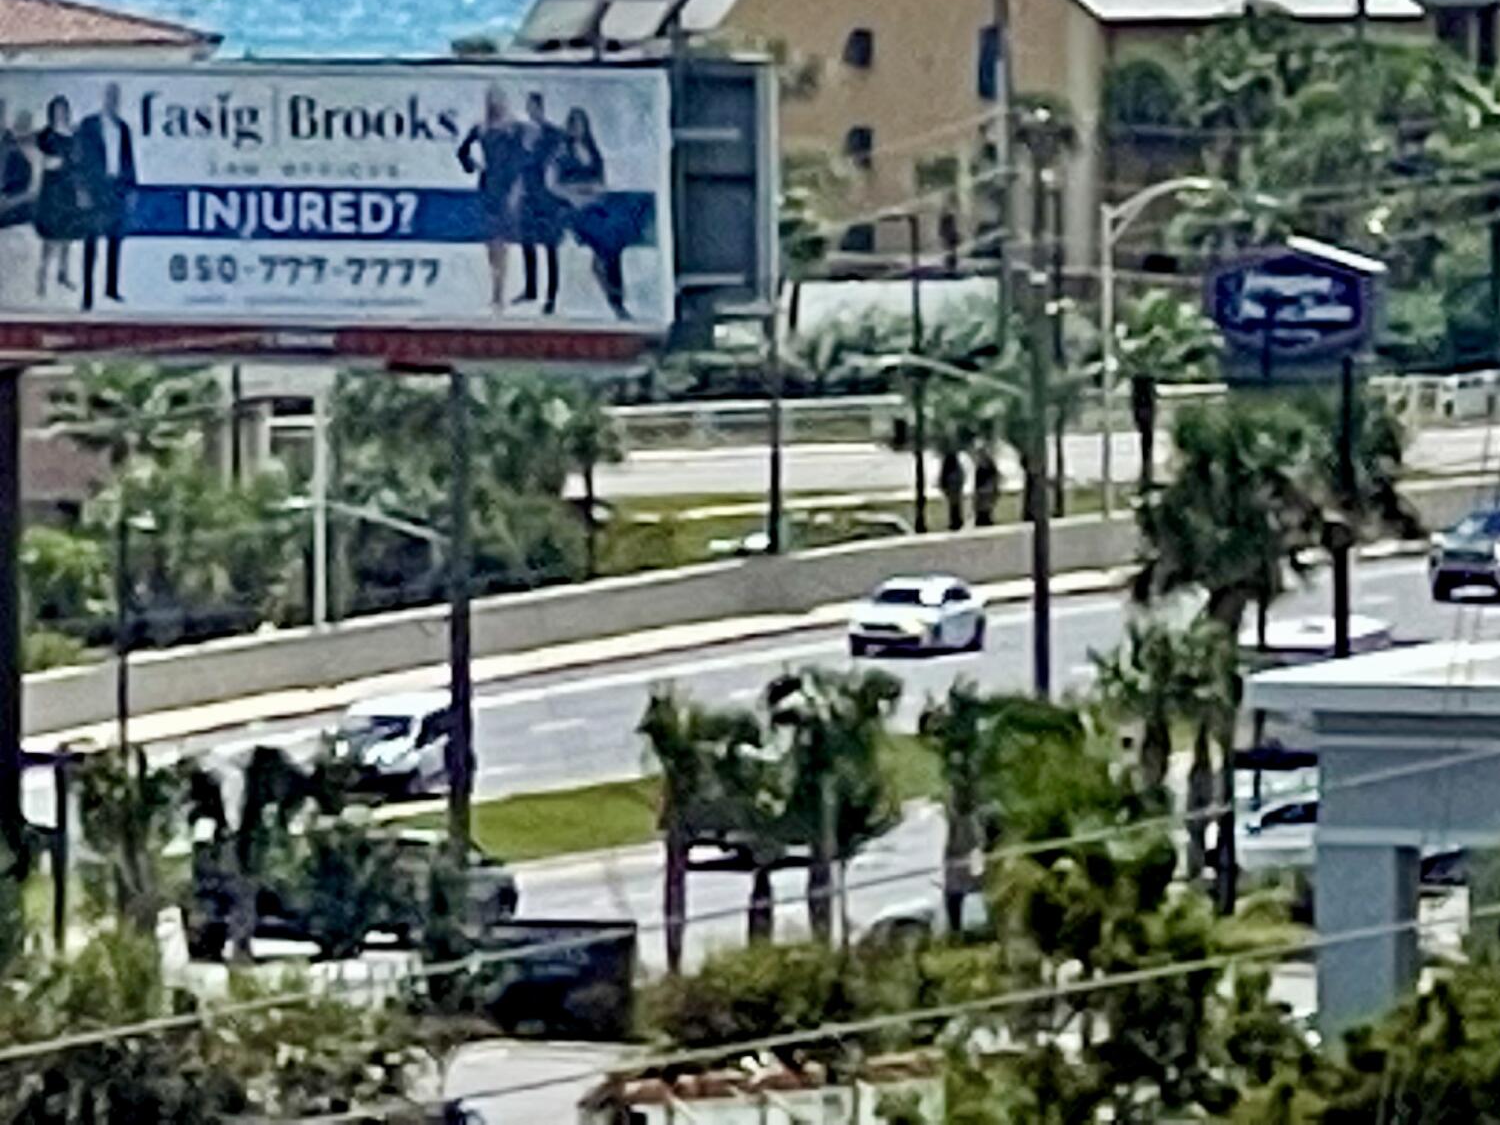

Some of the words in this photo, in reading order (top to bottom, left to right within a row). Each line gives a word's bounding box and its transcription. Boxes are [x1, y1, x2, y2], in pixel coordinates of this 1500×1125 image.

[287, 94, 458, 140] Brooks
[187, 190, 418, 237] INJURED?
[169, 253, 440, 286] 850-777-7777
